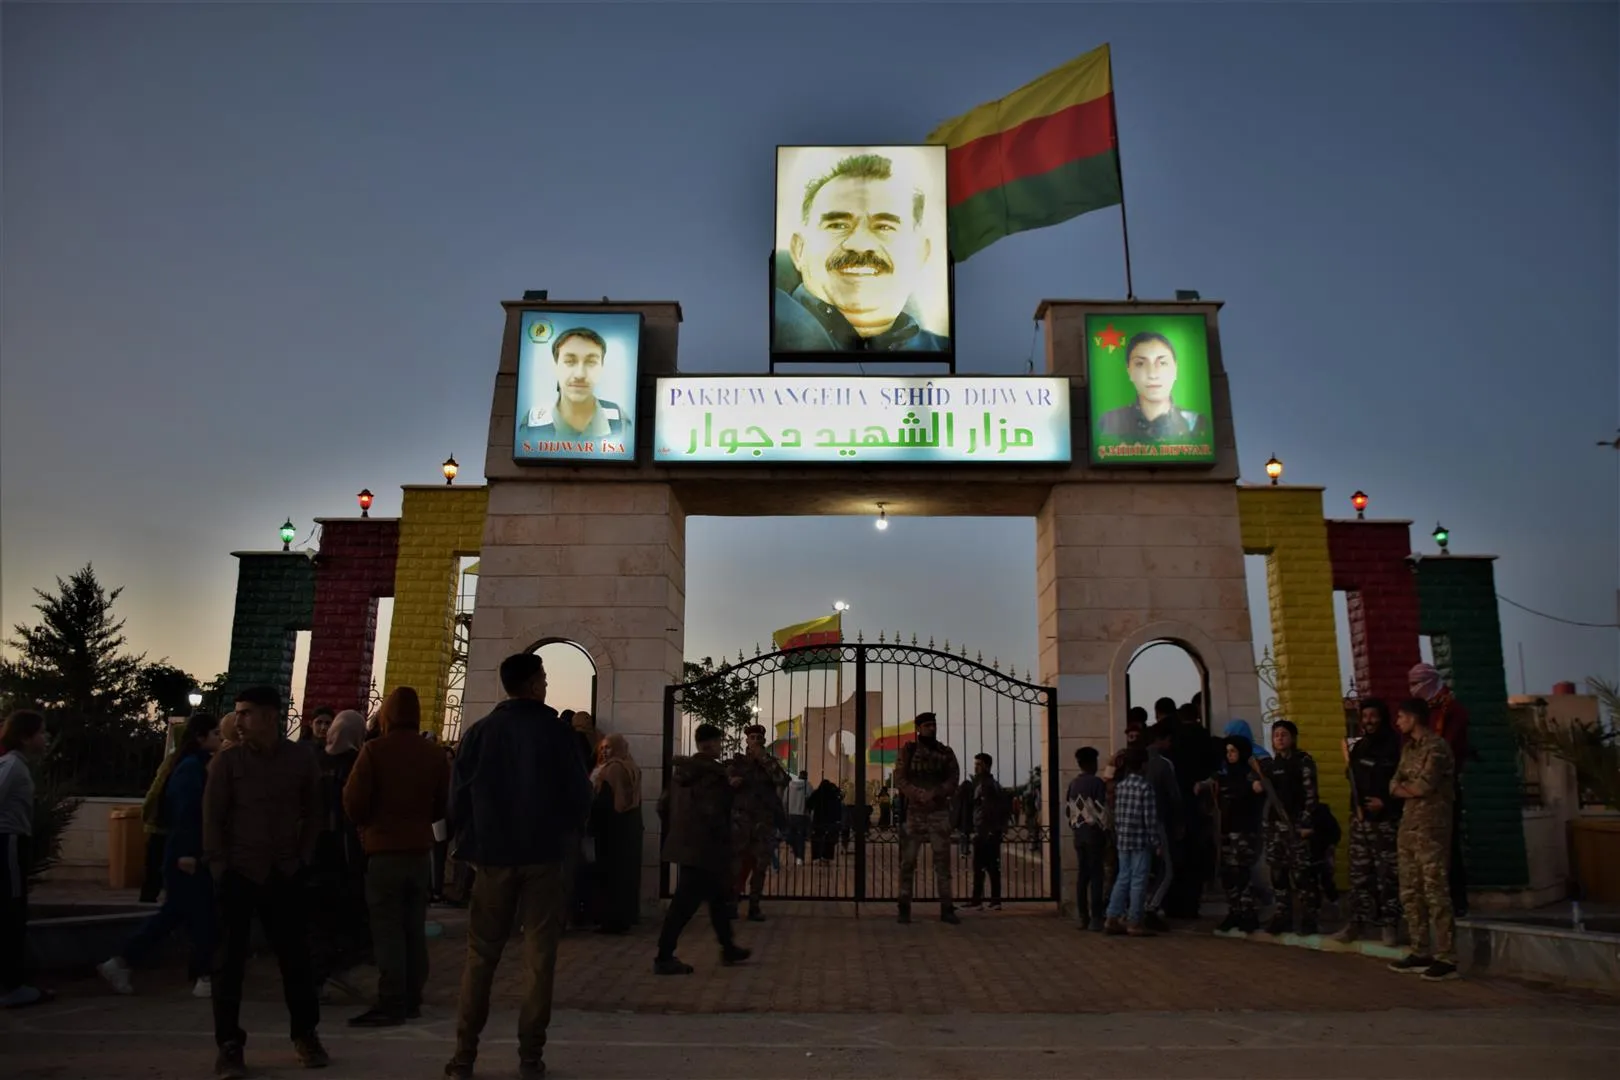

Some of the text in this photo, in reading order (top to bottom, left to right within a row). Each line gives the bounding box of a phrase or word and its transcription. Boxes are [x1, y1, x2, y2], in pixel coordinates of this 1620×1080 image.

[880, 381, 951, 409] ŞEHÎD
[964, 388, 1052, 406] DIJWAR
[686, 412, 1034, 457] مزار الشهيد دجوار
